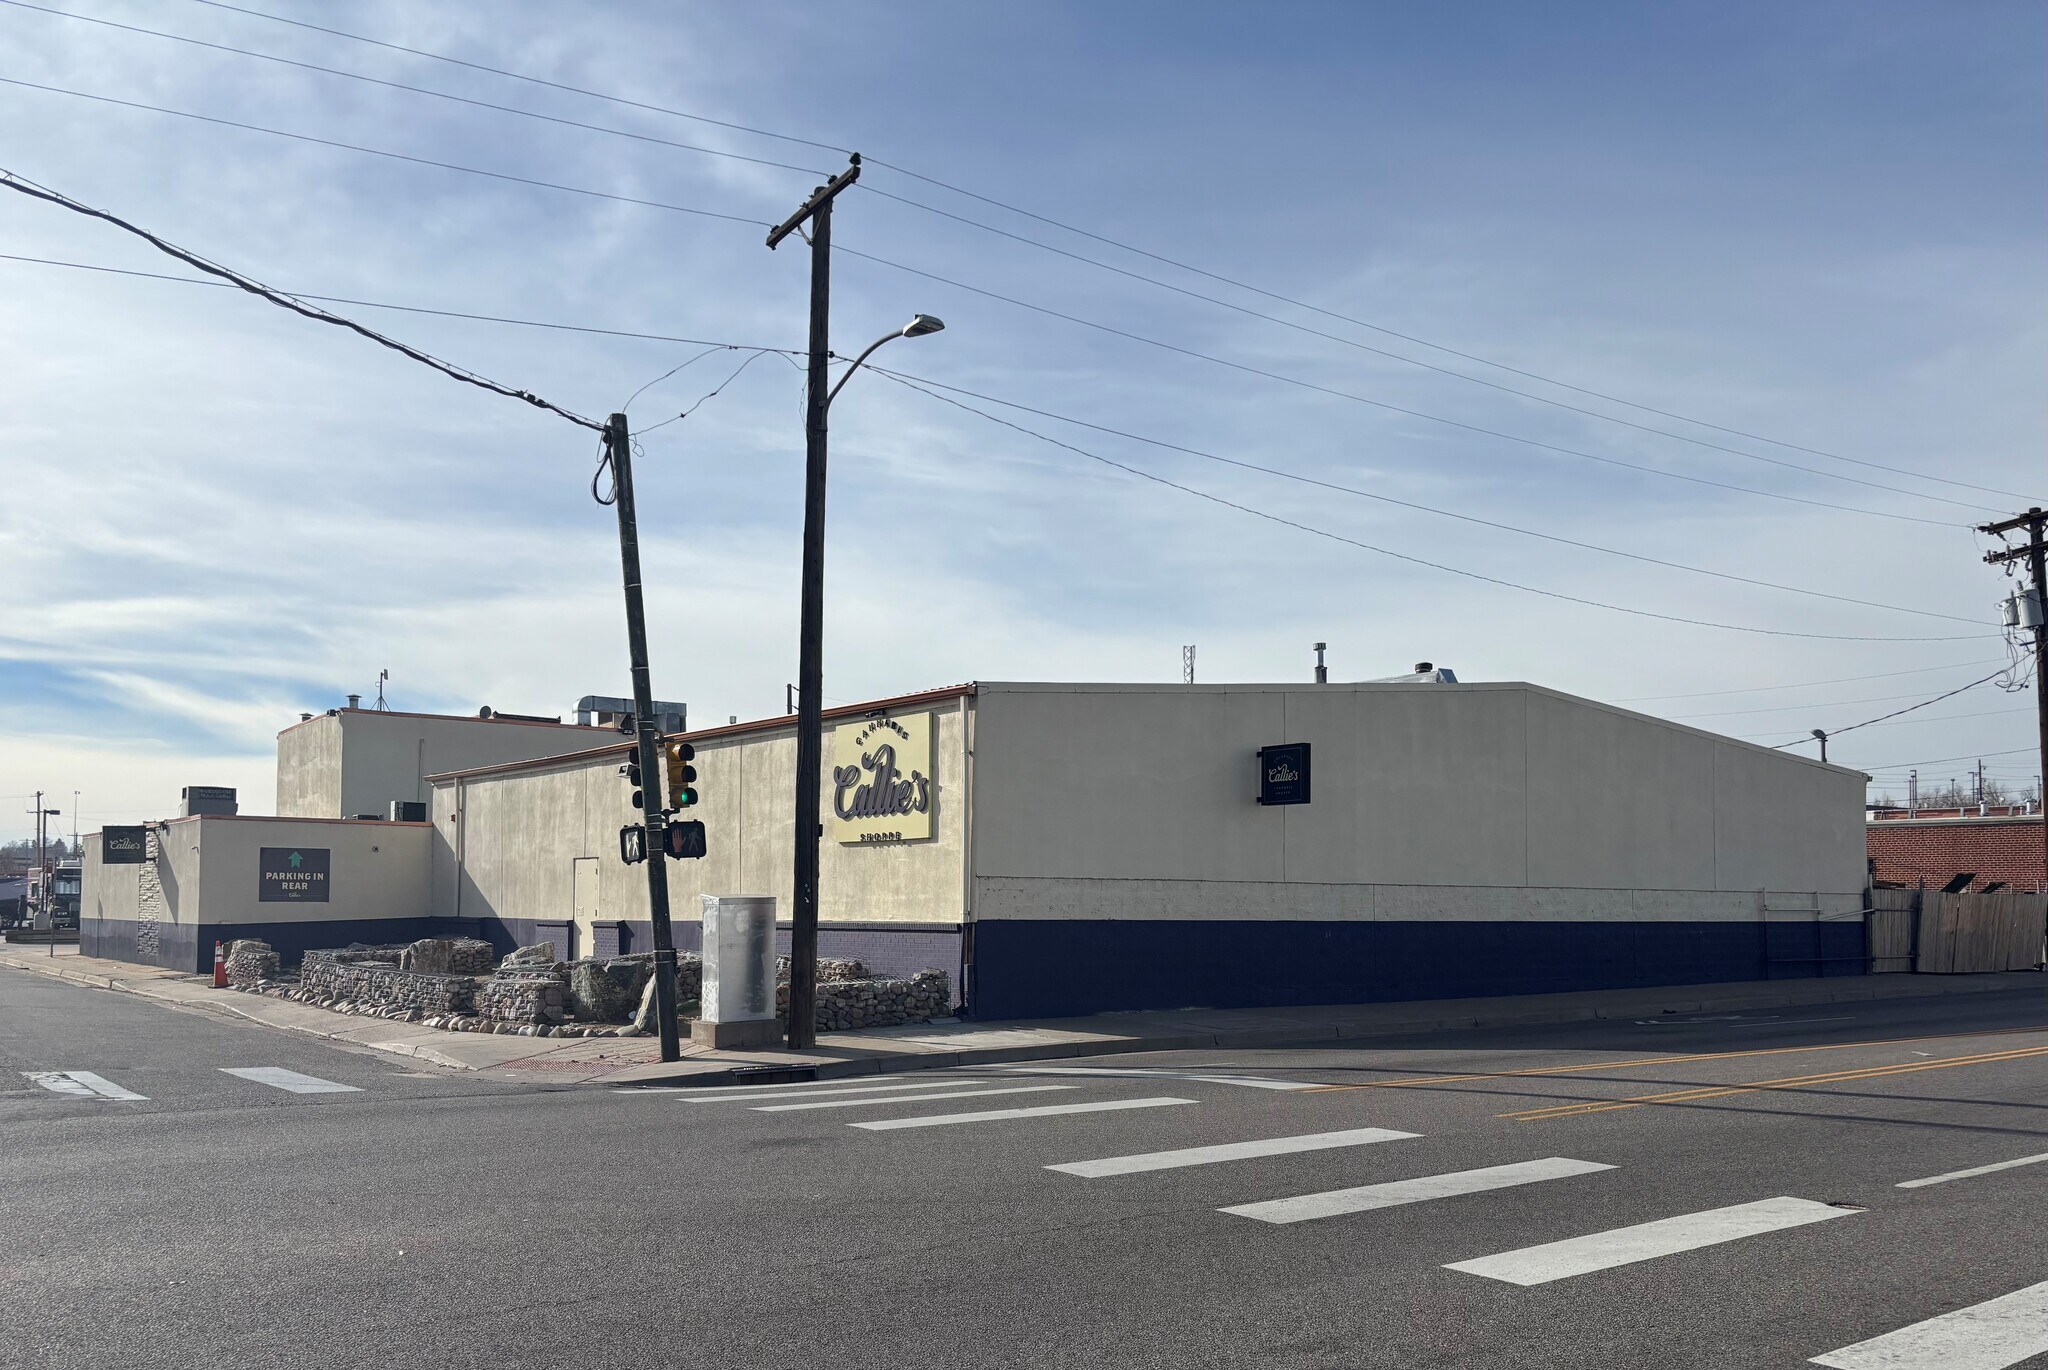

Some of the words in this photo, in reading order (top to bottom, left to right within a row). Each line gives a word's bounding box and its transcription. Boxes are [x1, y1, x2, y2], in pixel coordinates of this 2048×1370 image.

[1268, 763, 1299, 783] Callie's
[834, 744, 929, 821] Callie's
[109, 837, 141, 850] Callie's
[265, 872, 311, 880] PARKING
[313, 872, 324, 880] IN
[281, 882, 308, 890] REAR
